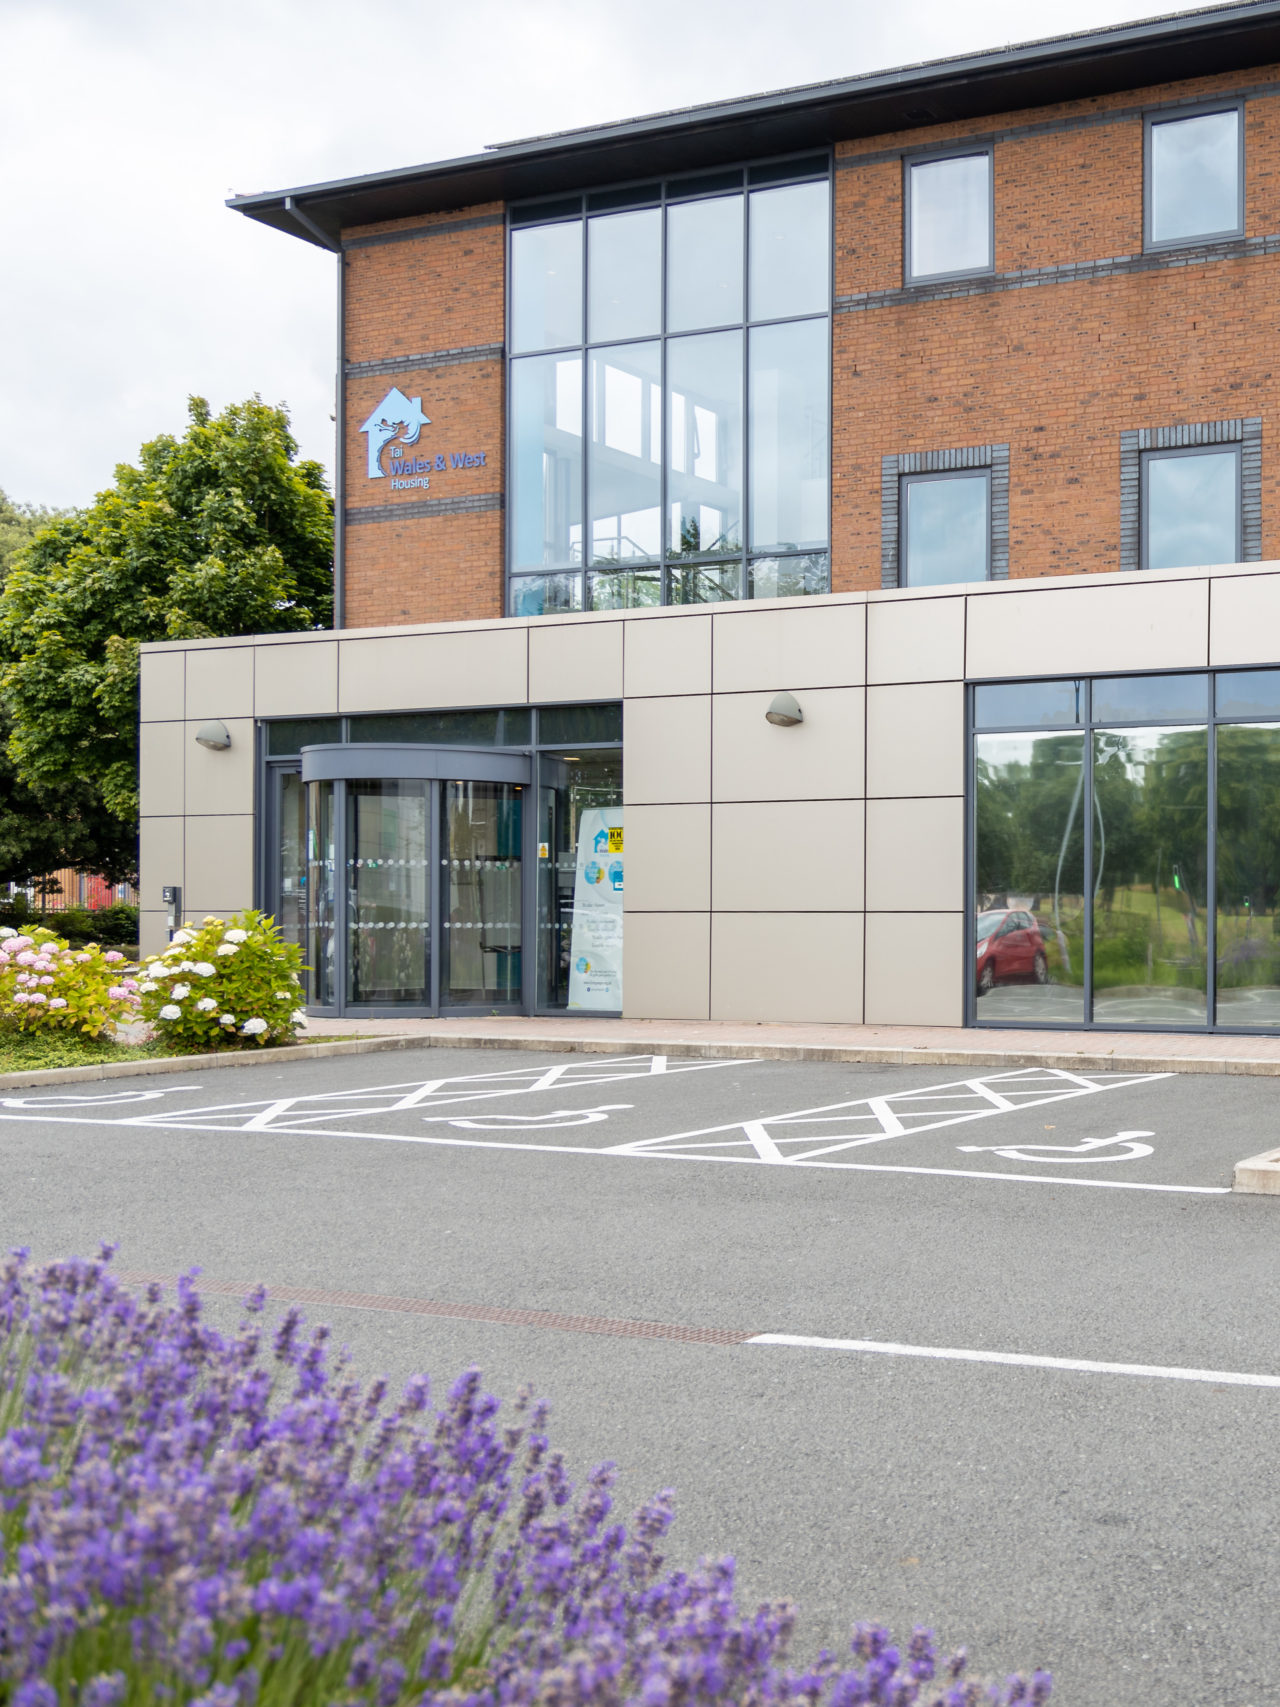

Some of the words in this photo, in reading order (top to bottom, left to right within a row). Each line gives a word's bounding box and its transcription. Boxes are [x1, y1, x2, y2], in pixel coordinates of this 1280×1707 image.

[390, 445, 403, 458] Tai
[390, 456, 431, 475] Wales
[434, 454, 447, 471] &
[449, 450, 486, 469] West
[391, 476, 430, 490] Housing
